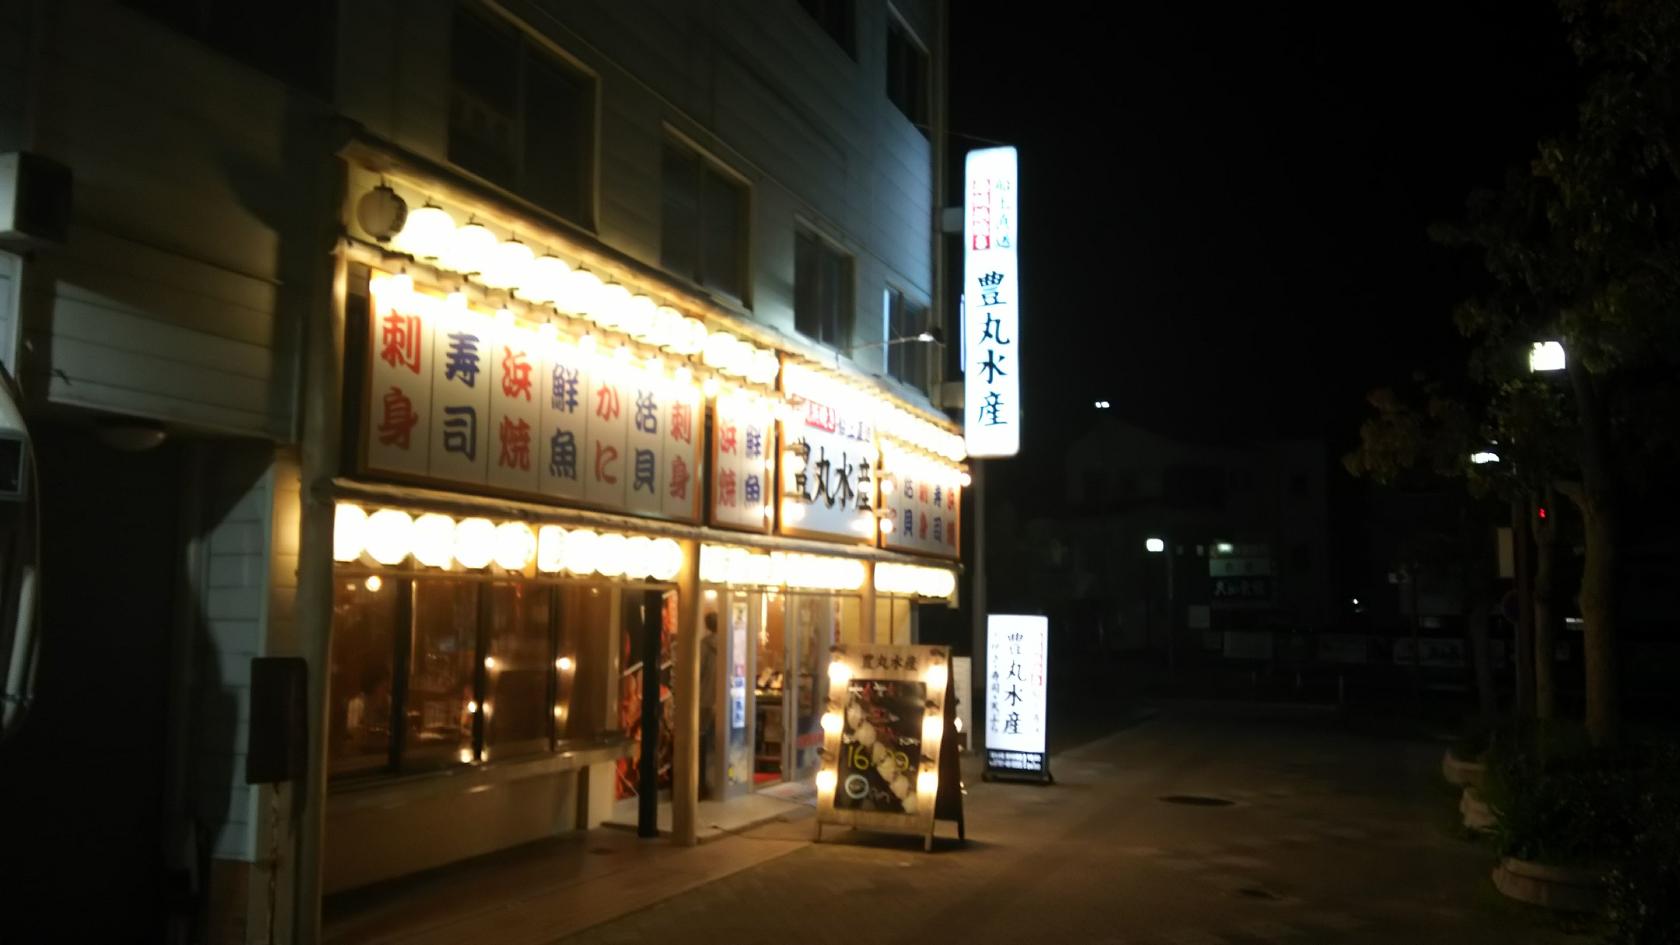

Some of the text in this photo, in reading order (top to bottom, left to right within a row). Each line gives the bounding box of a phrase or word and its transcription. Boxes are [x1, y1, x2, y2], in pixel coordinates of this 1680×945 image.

[378, 308, 422, 451] 刺身
[443, 332, 480, 463] 寿司
[976, 271, 1012, 427] 豊丸水産
[498, 345, 533, 472] 浜焼
[549, 362, 579, 482] 鮮魚
[594, 383, 621, 485] かに
[633, 389, 659, 495] 活貝
[669, 399, 693, 501] 刺身
[861, 653, 918, 672] 豊丸水産
[1003, 631, 1027, 735] 豊丸水産
